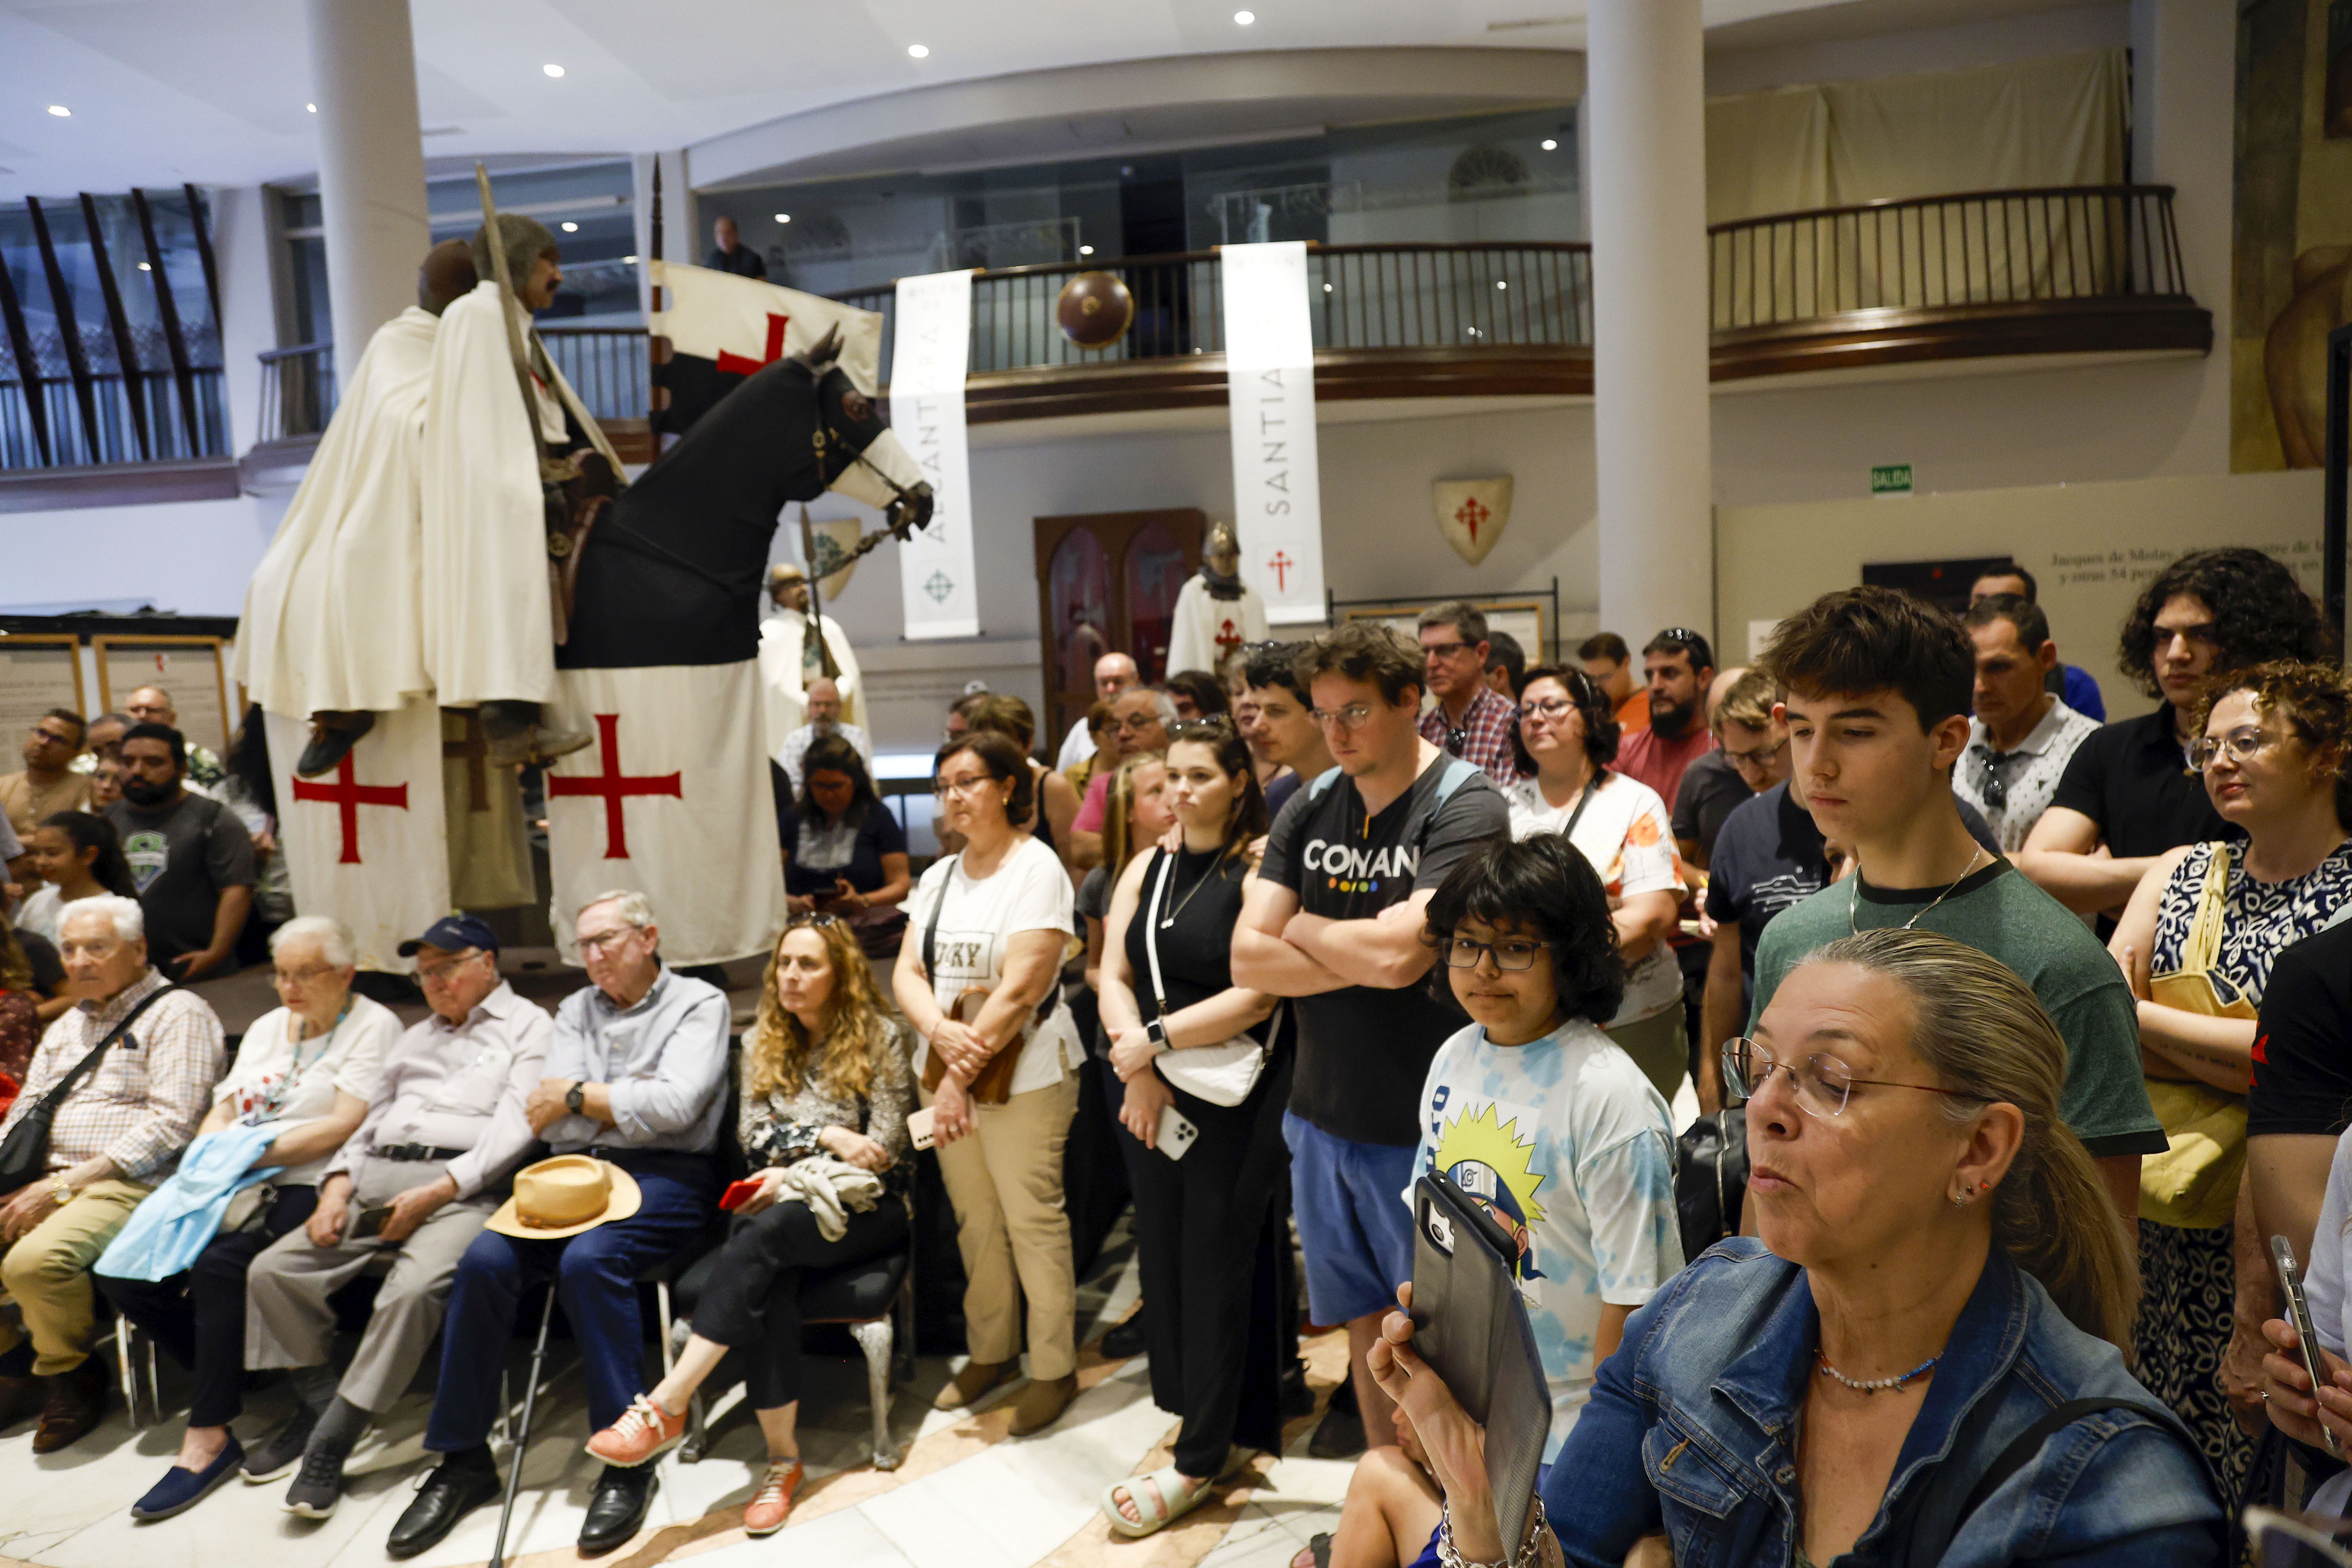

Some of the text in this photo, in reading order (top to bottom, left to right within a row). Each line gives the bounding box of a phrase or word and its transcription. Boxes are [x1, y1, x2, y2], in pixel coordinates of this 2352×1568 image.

[1257, 312, 1290, 516] SANTIA
[1873, 470, 1912, 488] SALIDA
[1304, 839, 1420, 879] CONAN
